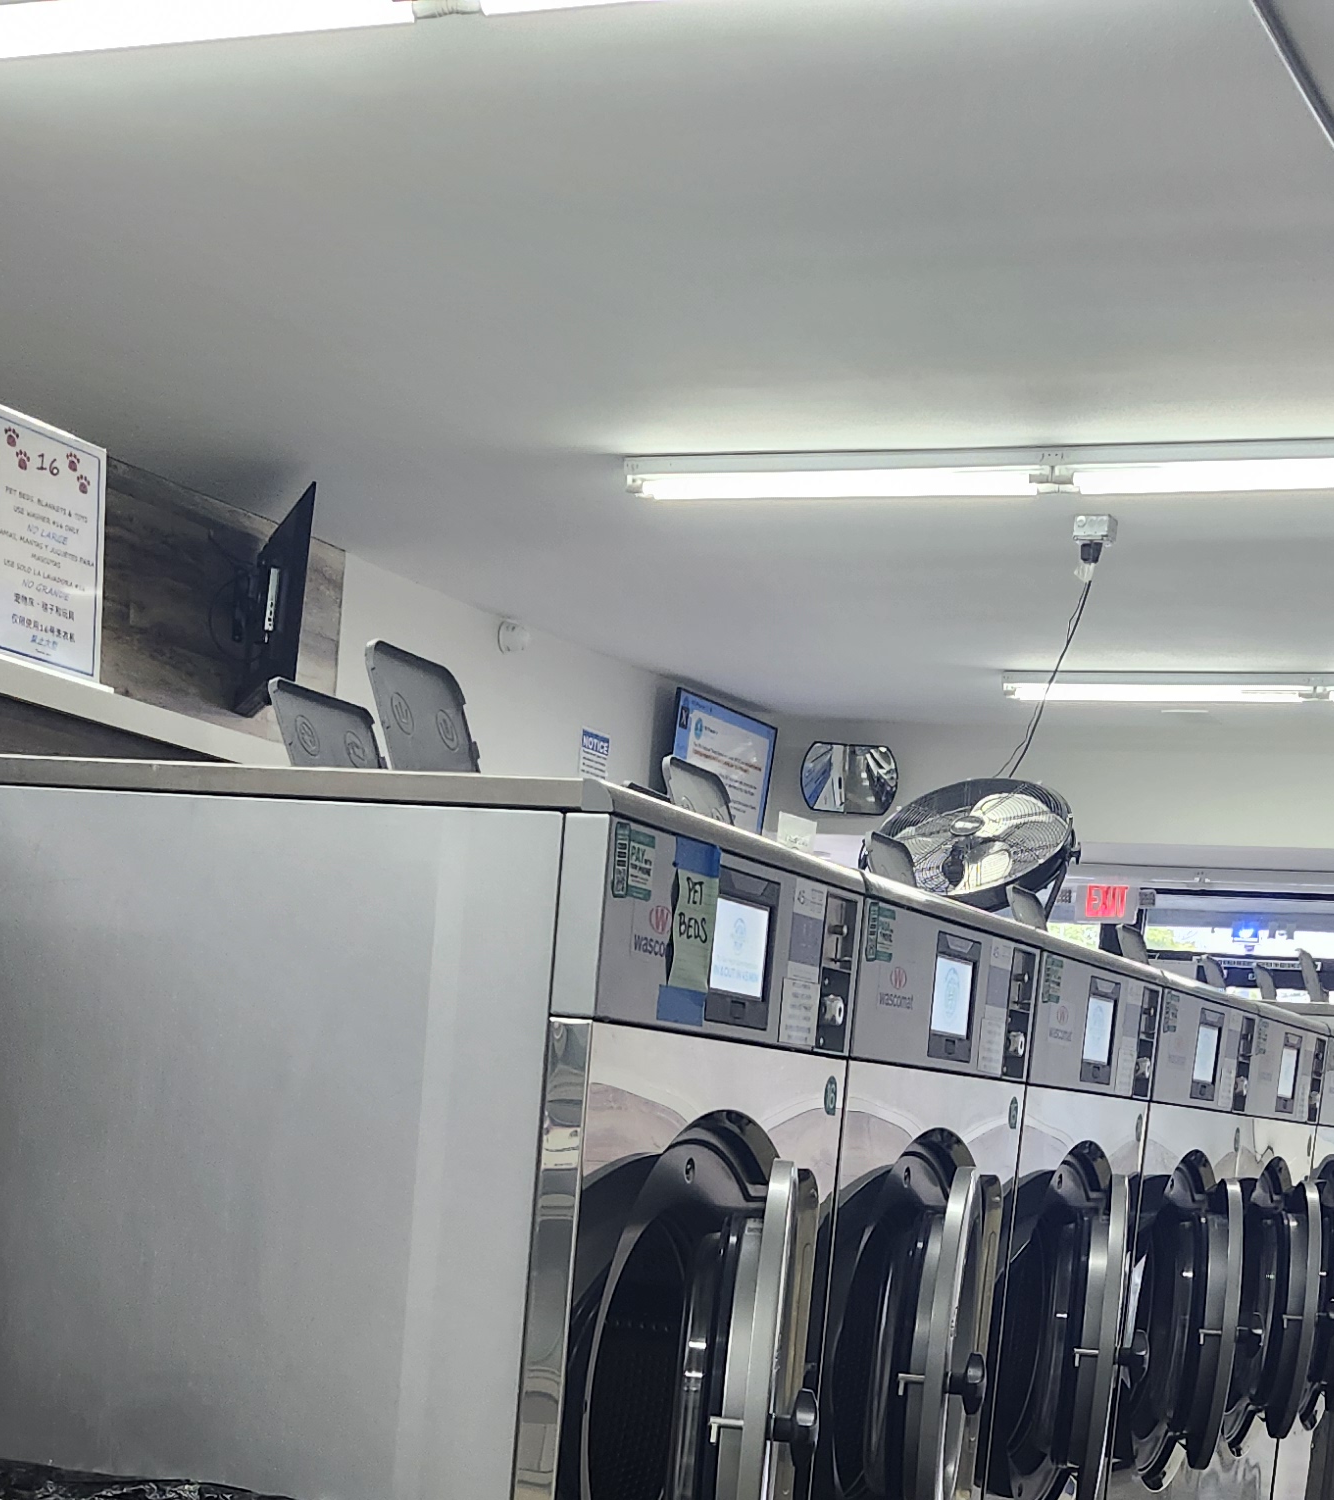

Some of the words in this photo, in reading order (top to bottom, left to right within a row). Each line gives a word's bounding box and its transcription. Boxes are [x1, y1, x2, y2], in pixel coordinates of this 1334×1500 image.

[36, 453, 60, 477] 16
[27, 524, 39, 534] NO
[22, 579, 34, 589] NO
[583, 735, 609, 754] NOTICE
[631, 845, 646, 864] PAY
[686, 876, 705, 905] PET
[1086, 884, 1129, 917] EXIT
[678, 911, 708, 943] BEDS
